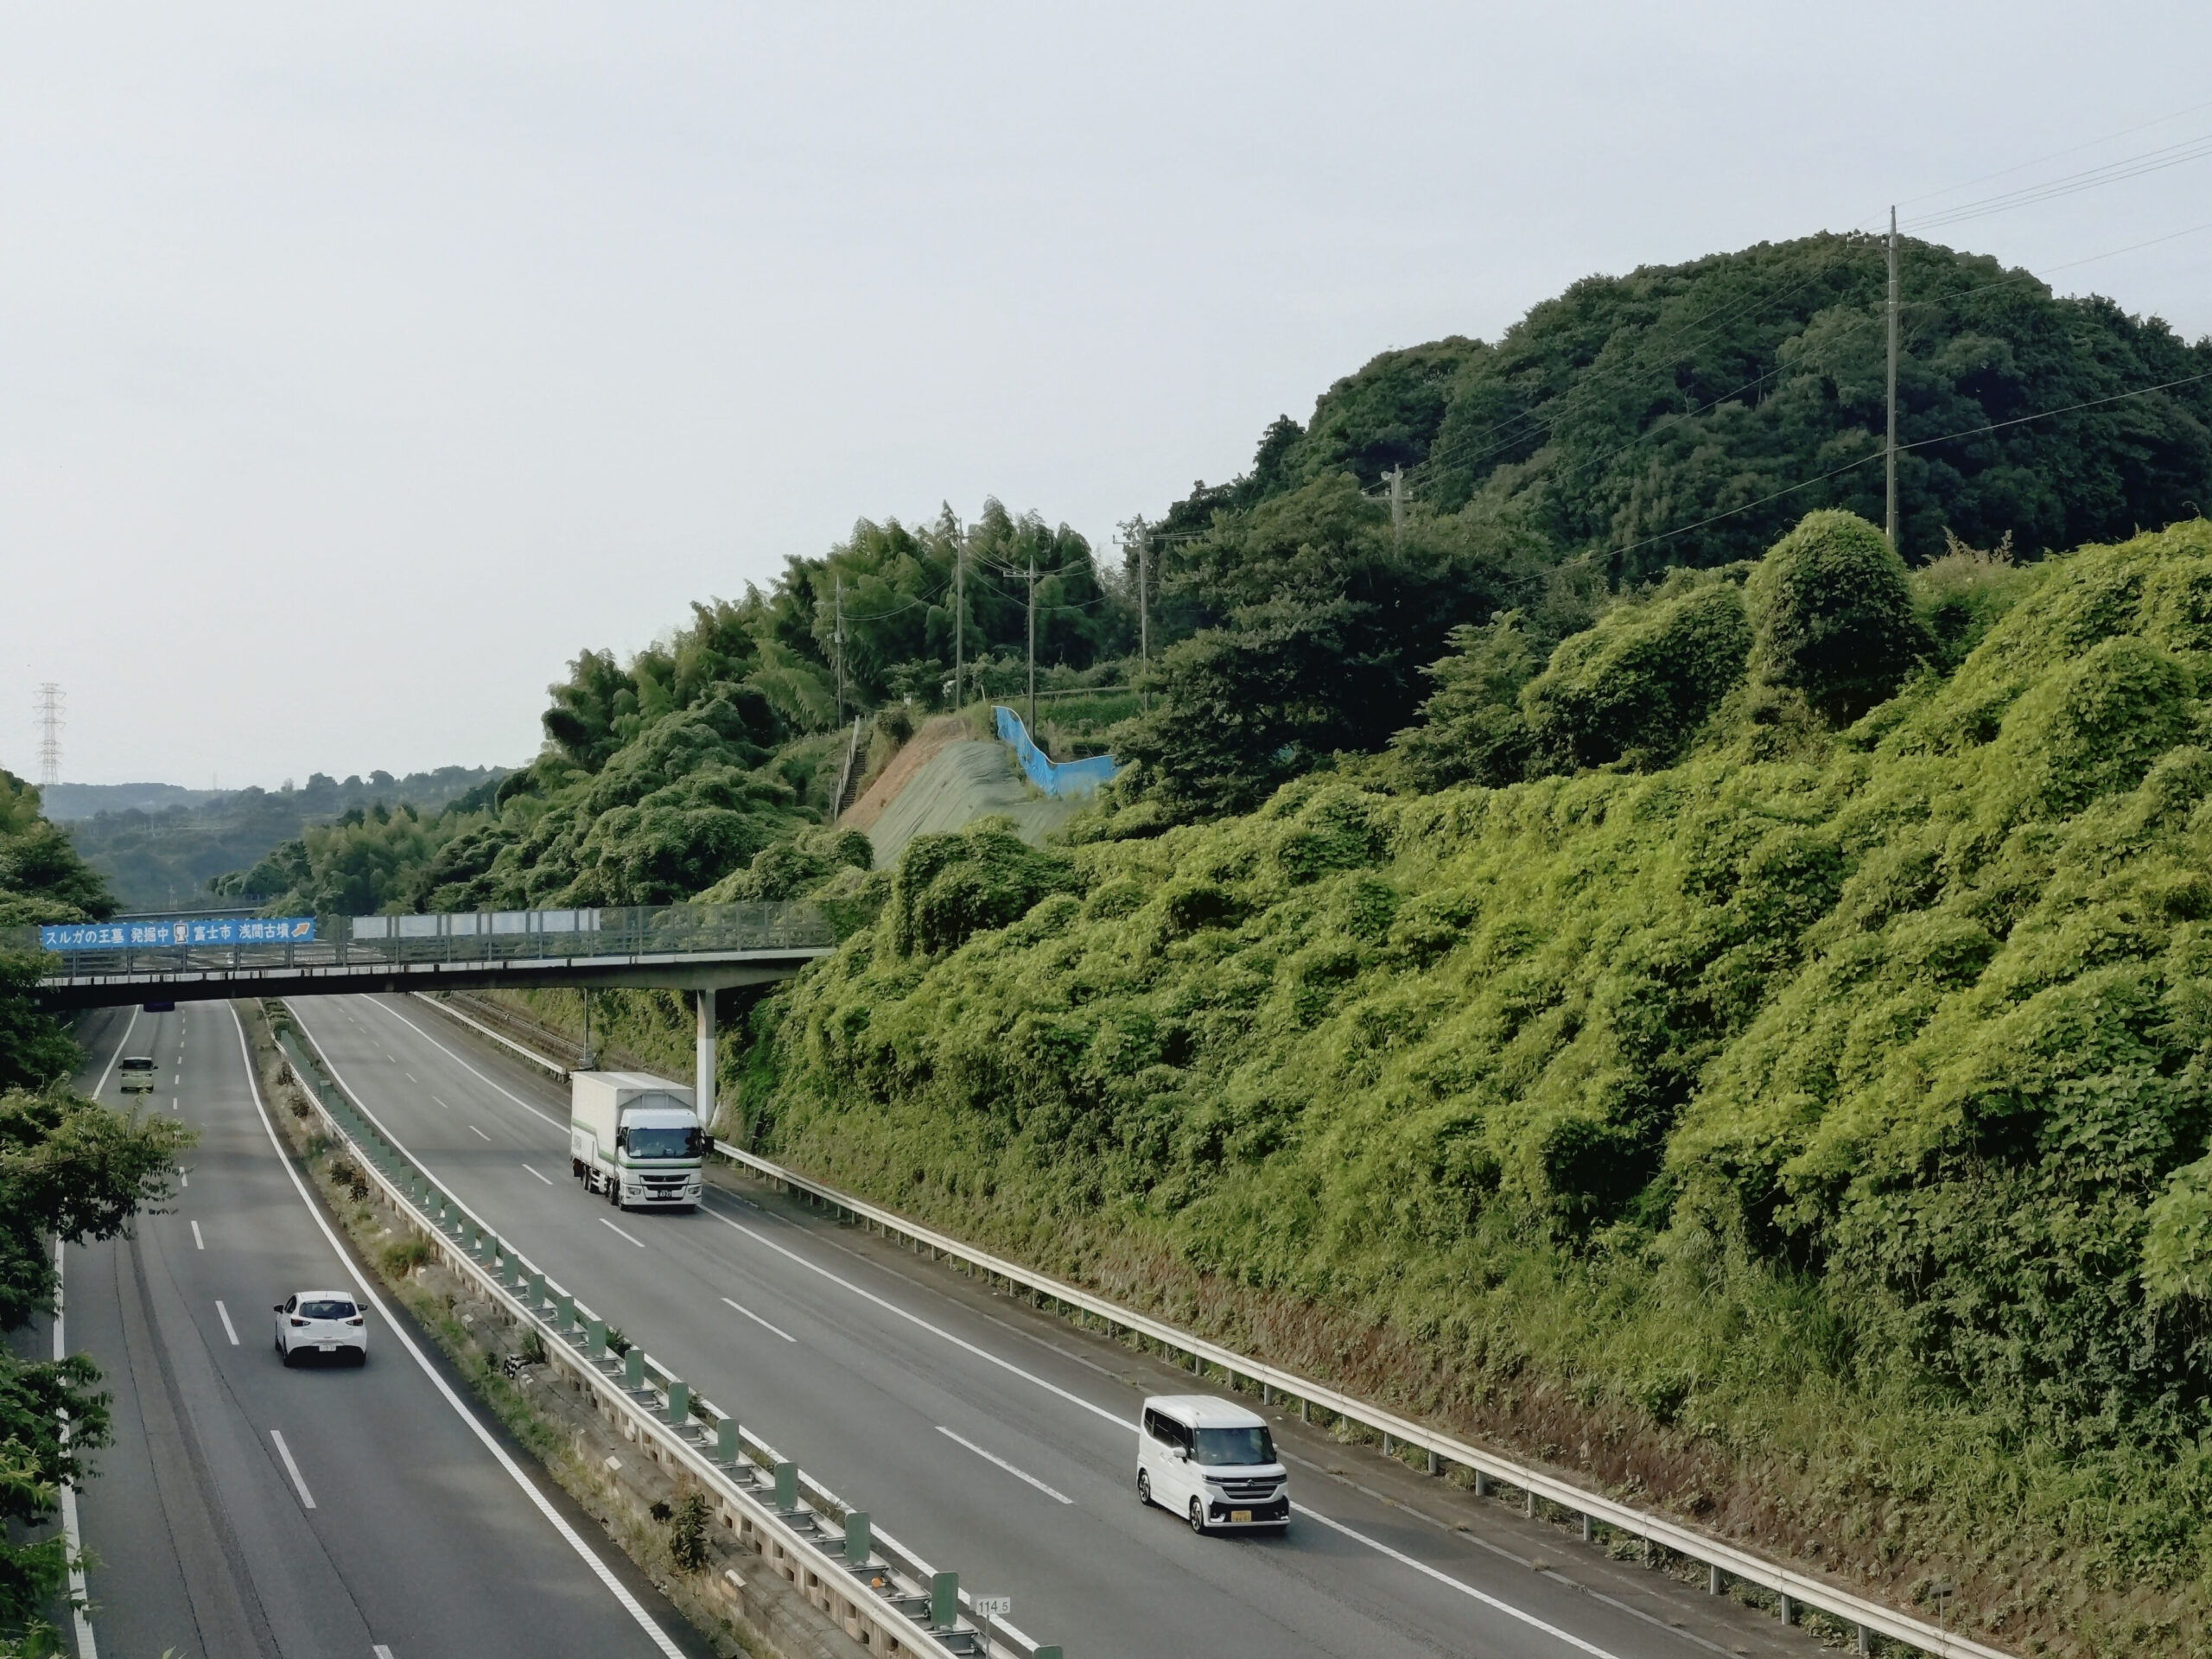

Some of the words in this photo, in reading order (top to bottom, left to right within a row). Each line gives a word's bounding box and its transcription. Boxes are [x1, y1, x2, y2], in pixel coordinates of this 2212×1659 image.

[46, 928, 124, 944] スルガの王墓
[130, 926, 168, 943] 発掘中
[194, 924, 232, 941] 富士市
[238, 922, 289, 939] 浅間古墳
